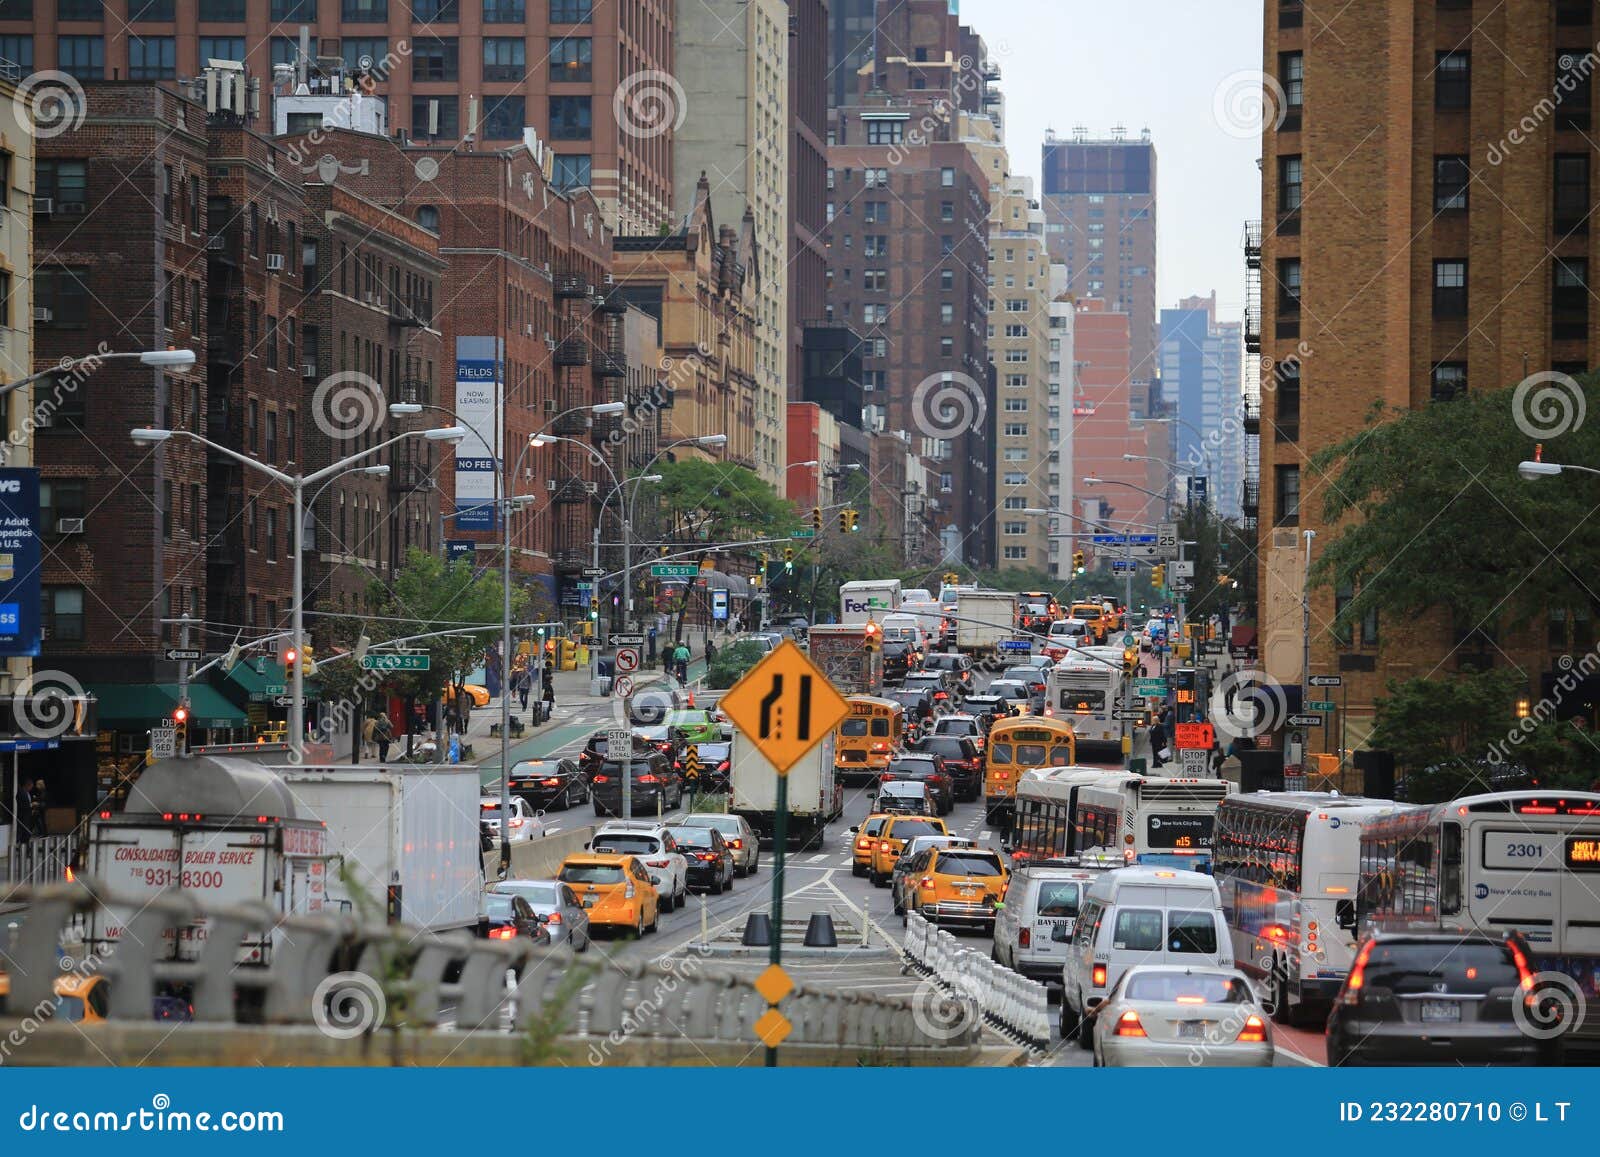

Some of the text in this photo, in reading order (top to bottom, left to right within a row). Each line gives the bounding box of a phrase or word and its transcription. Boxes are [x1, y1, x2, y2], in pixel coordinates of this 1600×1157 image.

[5, 517, 29, 525] Adult
[1160, 537, 1175, 546] 25
[1507, 844, 1542, 857] 2301
[115, 847, 254, 865] CONSOLIDATED BOILER SERVICE
[1038, 918, 1068, 926] BAYSIDE
